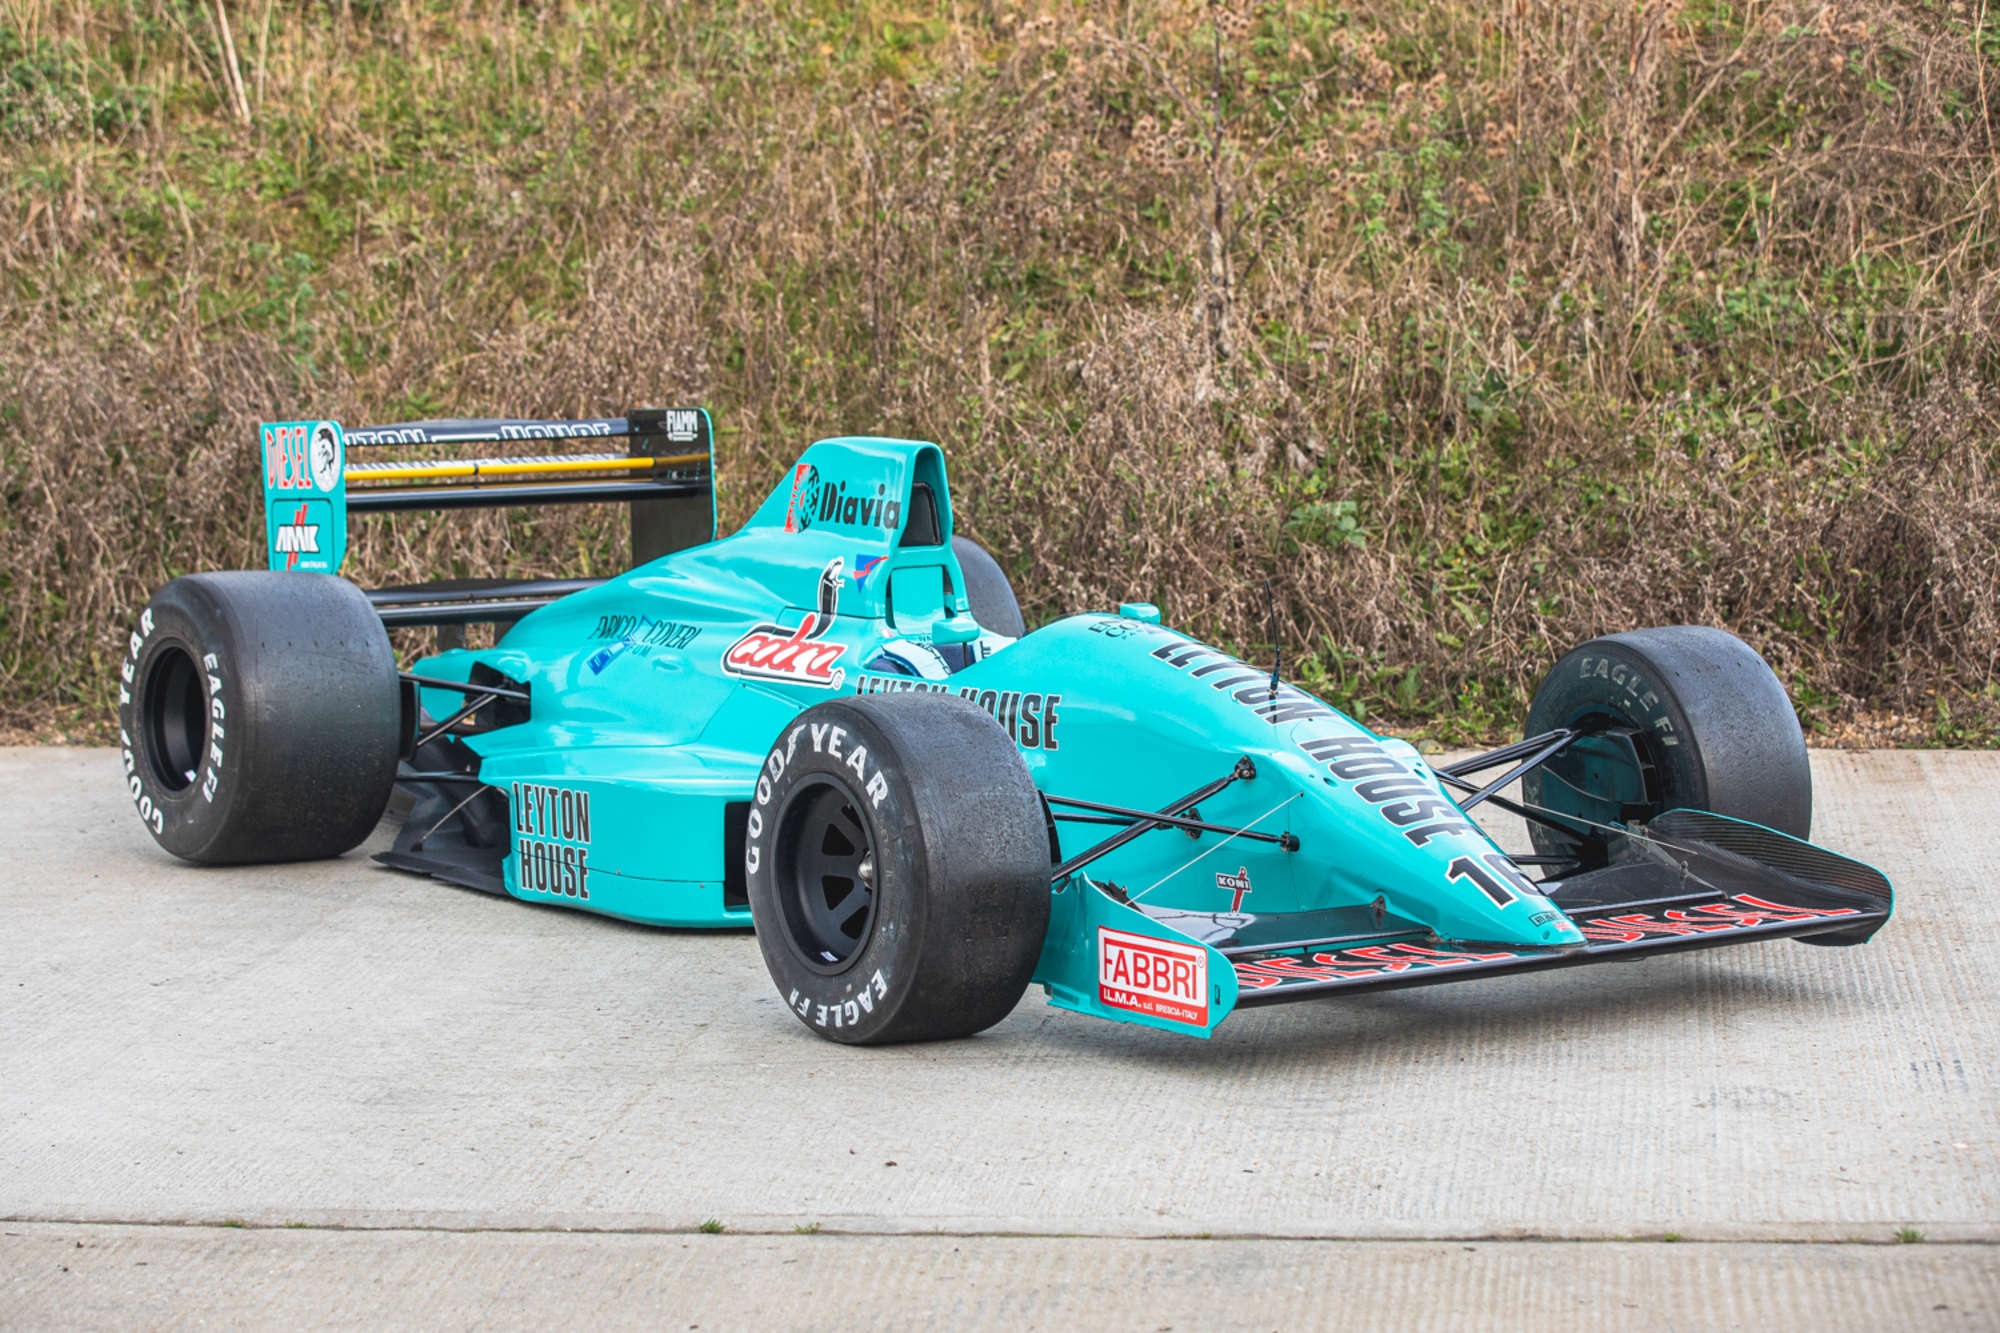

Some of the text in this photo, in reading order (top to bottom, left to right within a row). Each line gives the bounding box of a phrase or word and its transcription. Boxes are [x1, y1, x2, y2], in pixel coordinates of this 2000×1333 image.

[666, 410, 698, 432] FIAMM
[264, 425, 313, 490] DIESEL
[818, 480, 901, 529] Diavia
[203, 652, 226, 767] EAGLE
[1580, 658, 1659, 711] EAGLE
[512, 781, 592, 844] LEYTON
[1298, 736, 1485, 848] HOUSE
[518, 838, 590, 901] HOUSE
[1217, 875, 1250, 890] KONI
[816, 968, 888, 1027] EAGLE
[1103, 937, 1197, 1001] FABBRI
